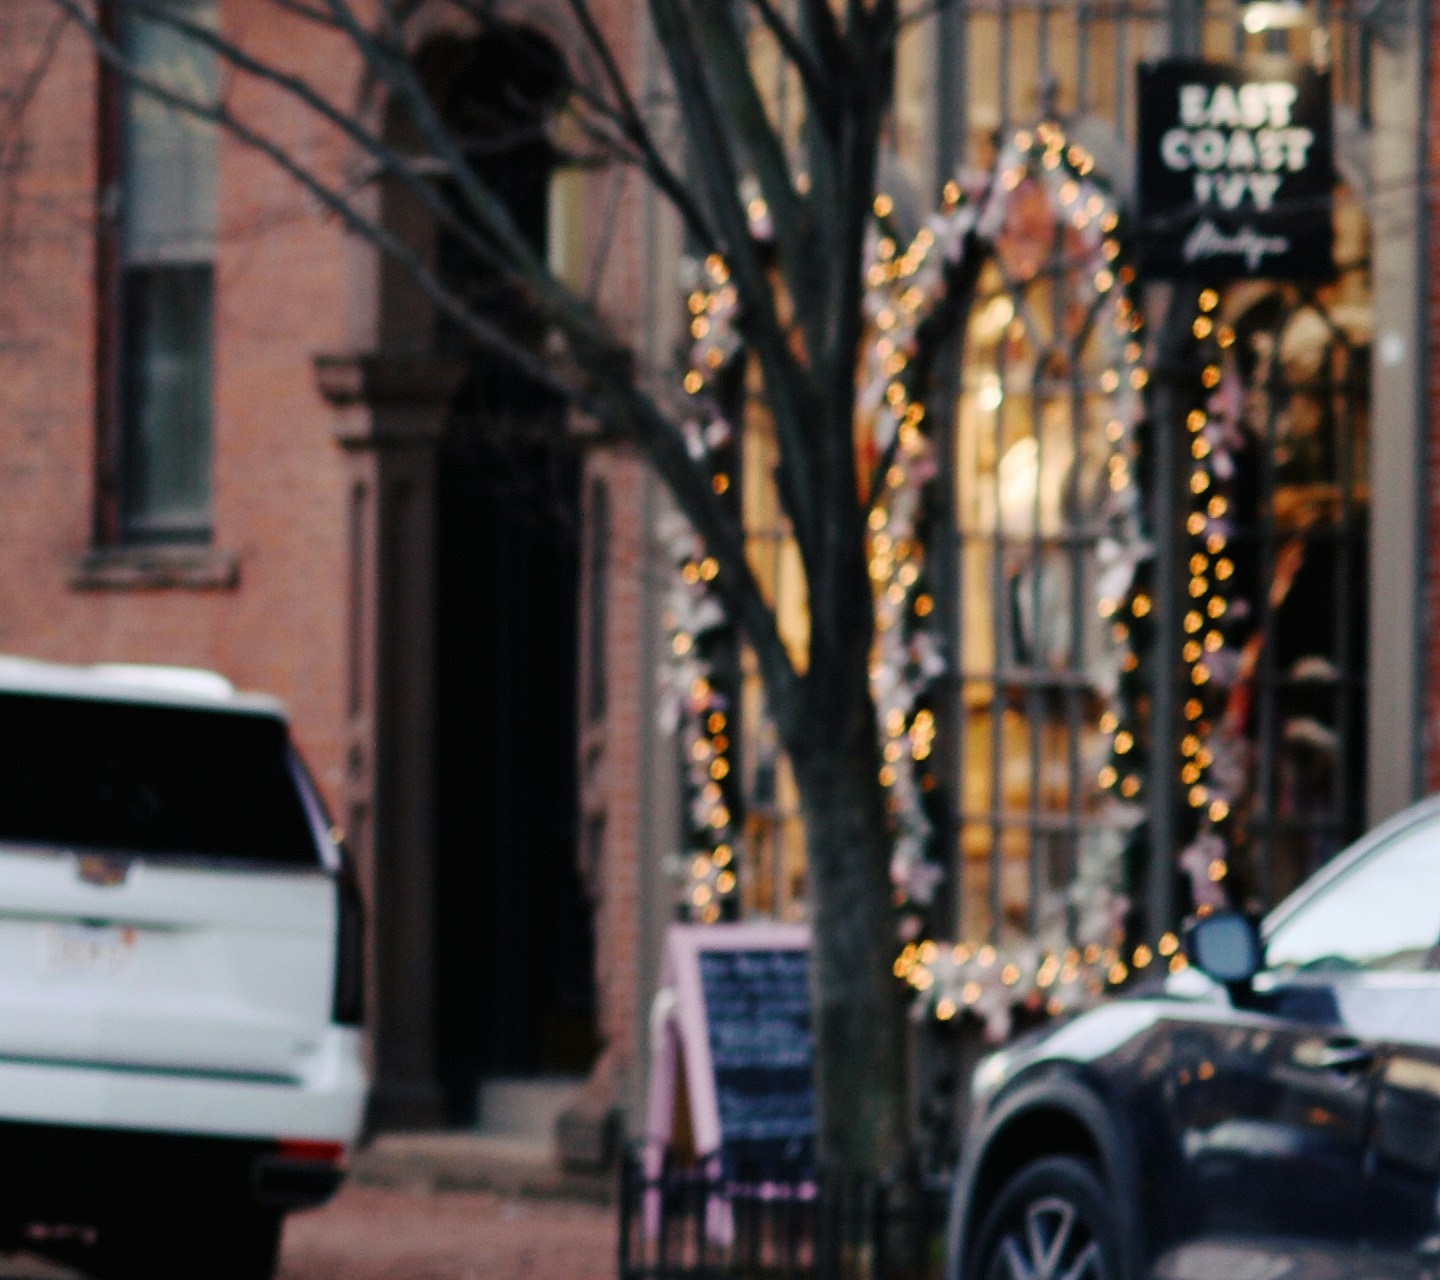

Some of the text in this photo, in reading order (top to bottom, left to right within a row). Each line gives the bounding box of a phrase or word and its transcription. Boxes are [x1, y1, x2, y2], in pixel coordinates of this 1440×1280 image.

[1179, 83, 1297, 126] EAST
[1161, 129, 1315, 171] COAST
[1194, 174, 1282, 212] IVY
